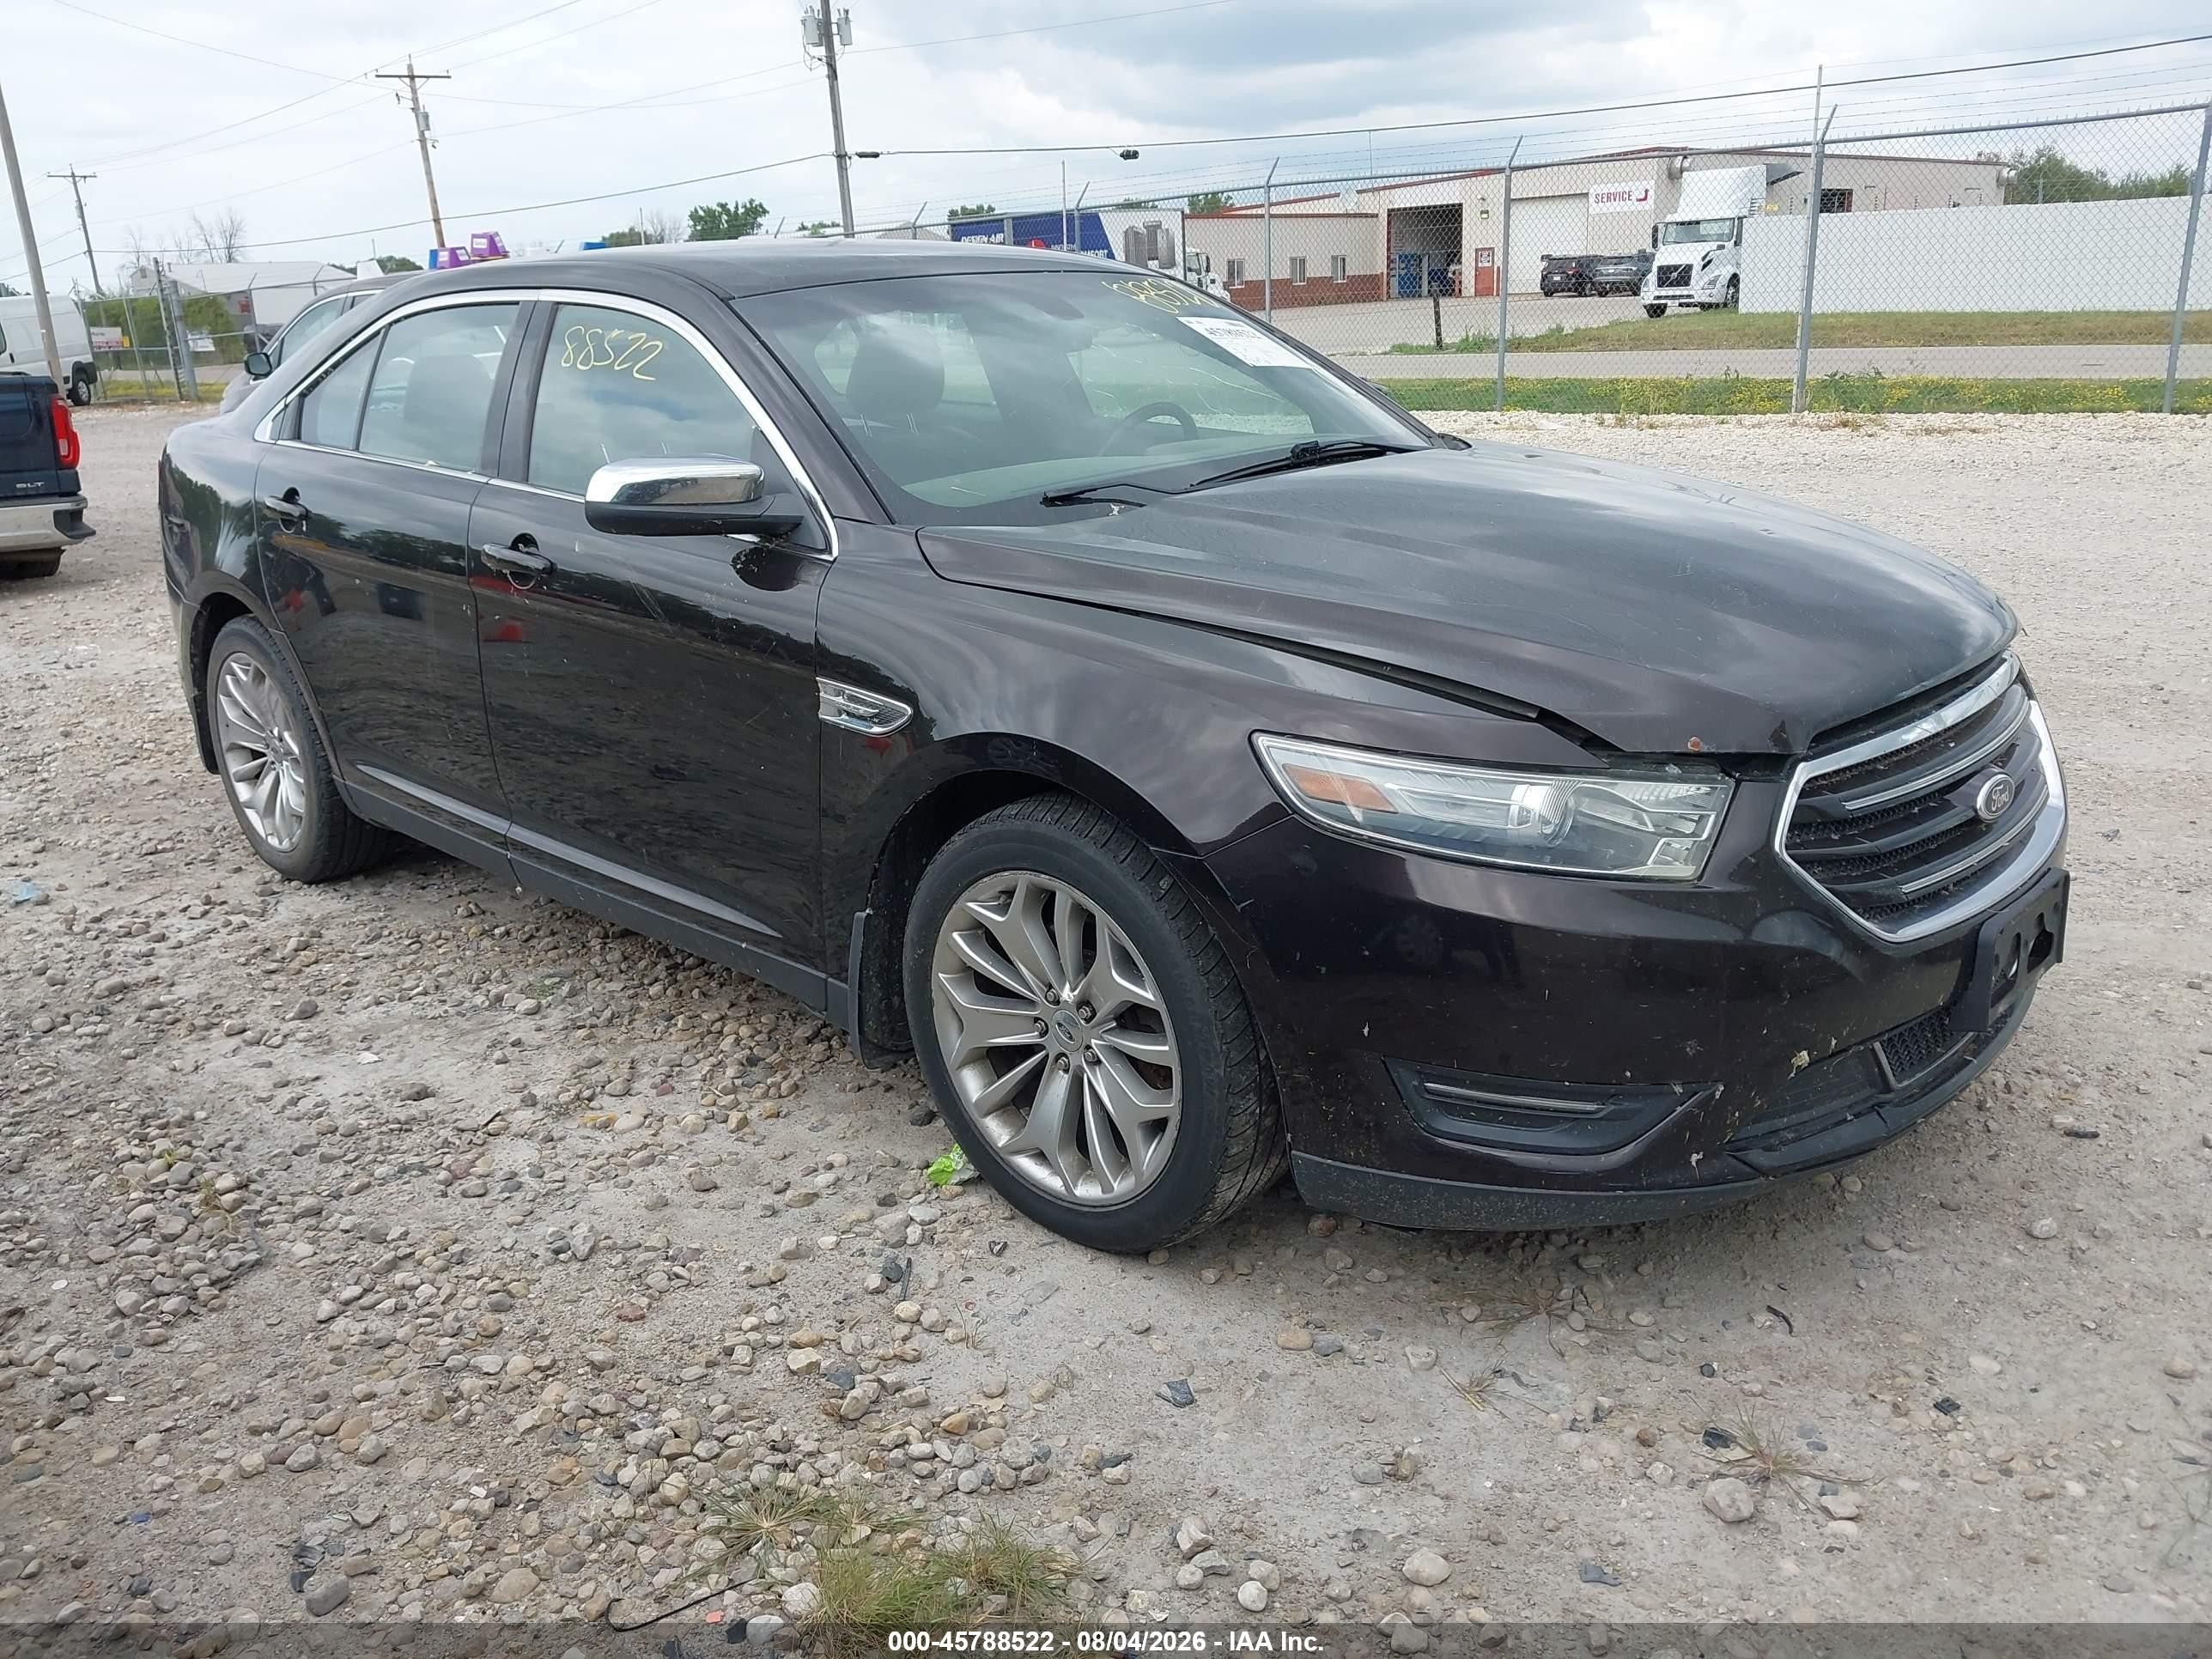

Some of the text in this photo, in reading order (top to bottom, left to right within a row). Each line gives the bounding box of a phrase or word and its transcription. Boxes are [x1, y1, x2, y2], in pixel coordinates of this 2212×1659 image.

[1595, 190, 1632, 204] SERVICE
[961, 233, 1004, 244] DESIGN AIR
[561, 325, 663, 380] 88522
[1992, 783, 2009, 811] Ford
